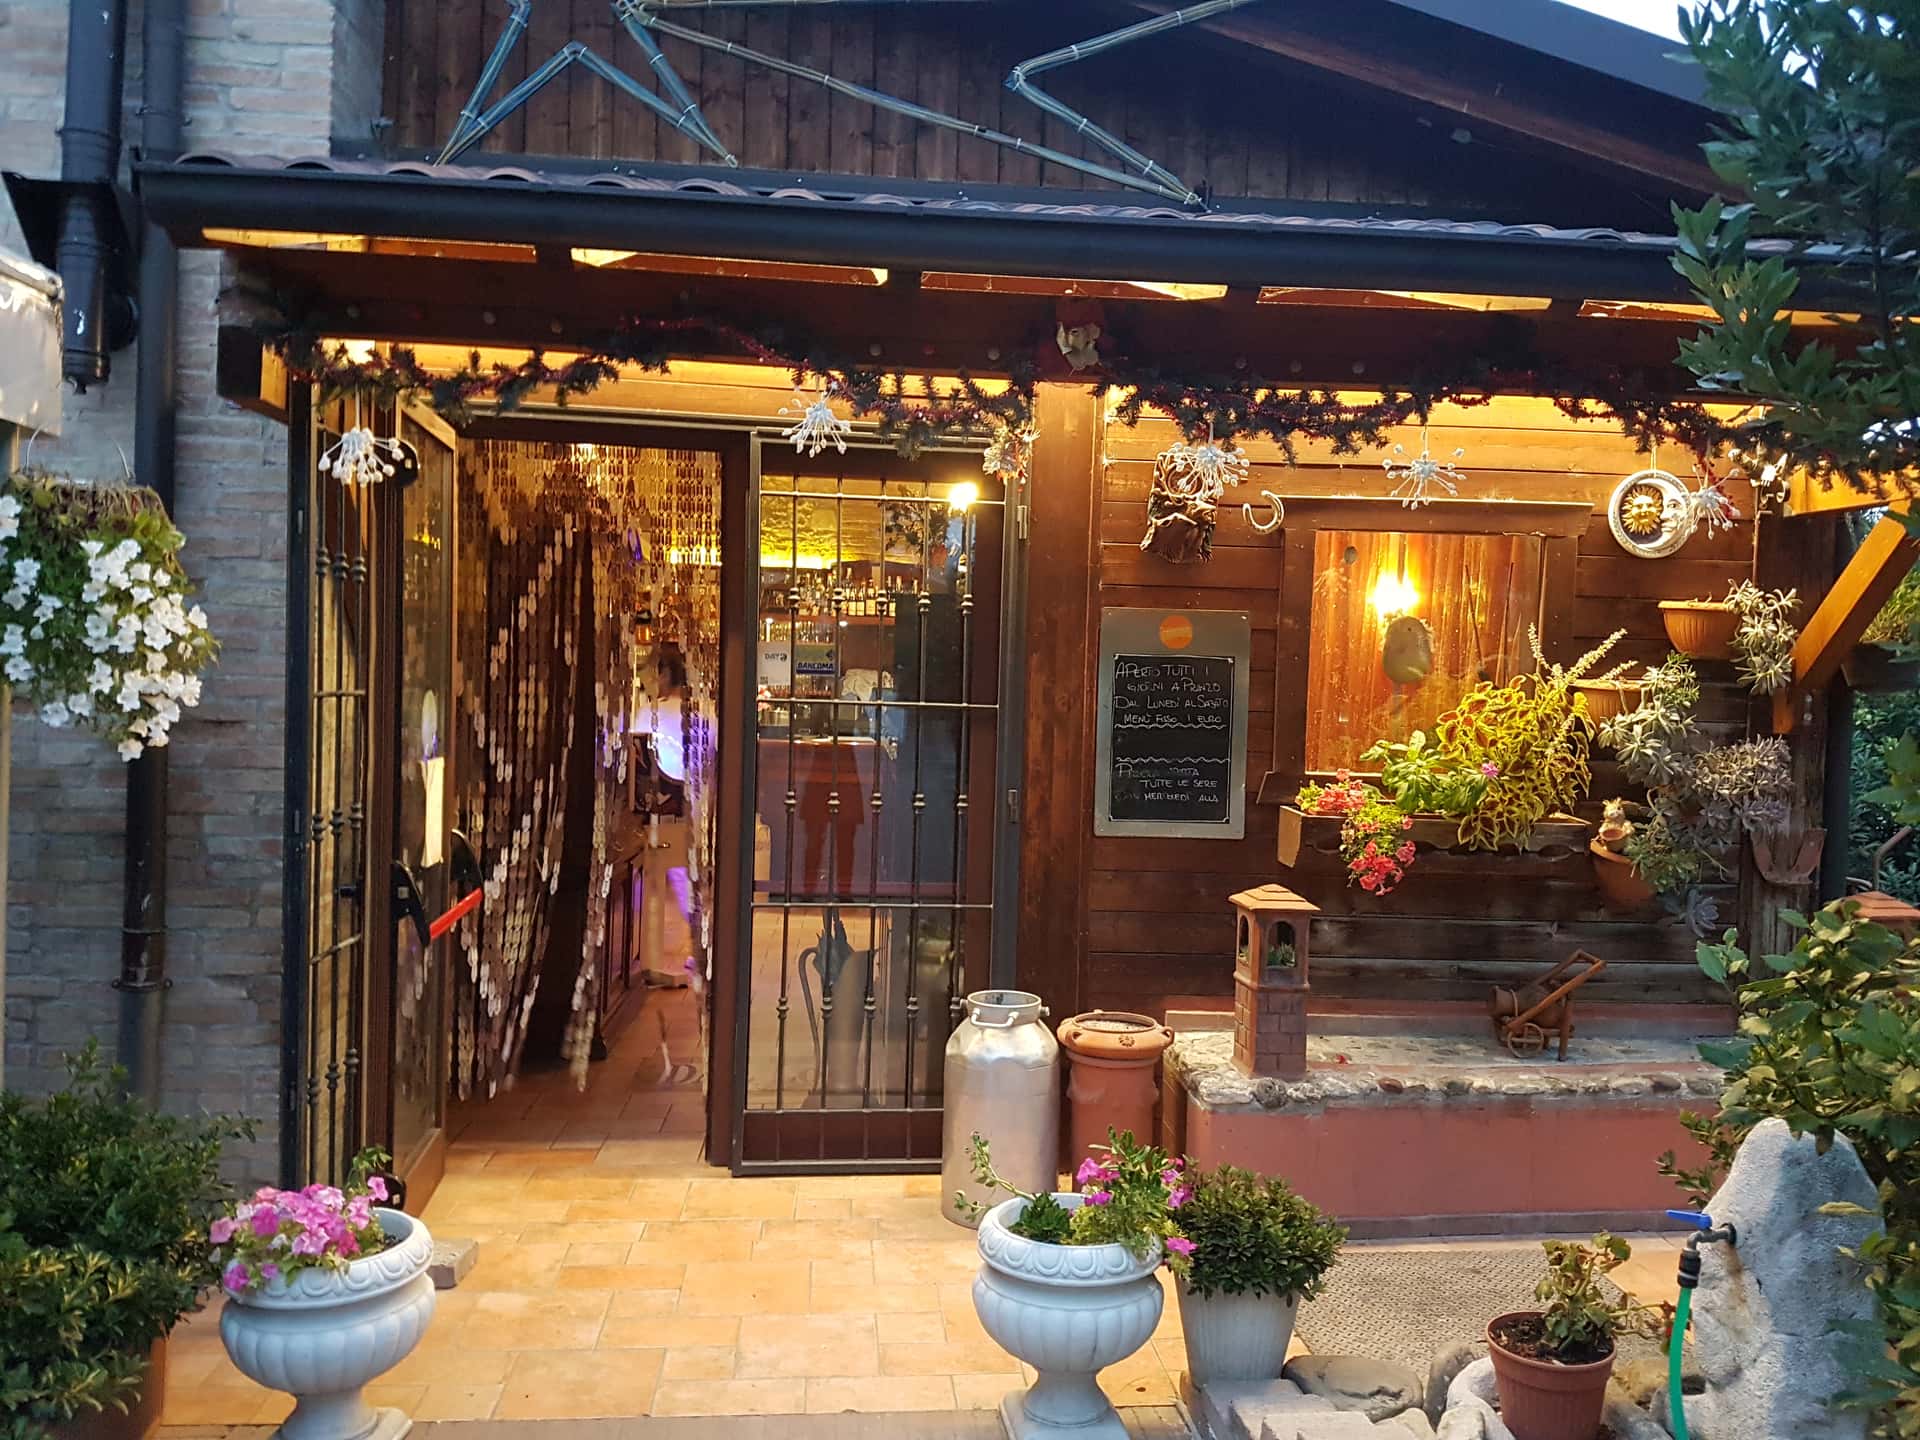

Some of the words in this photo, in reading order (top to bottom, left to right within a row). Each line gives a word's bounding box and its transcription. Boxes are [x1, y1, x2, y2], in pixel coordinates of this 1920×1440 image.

[797, 662, 835, 670] BANCOMA
[1115, 662, 1160, 679] APERTO
[1161, 664, 1195, 677] TUTTI
[1171, 682, 1180, 692] A
[1114, 696, 1139, 709] DAL
[1184, 699, 1196, 708] AL
[1156, 714, 1177, 723] FISSO
[1197, 714, 1221, 723] EURO
[1139, 779, 1173, 788] TUTTE
[1177, 779, 1190, 787] LE
[1193, 779, 1218, 788] SERE
